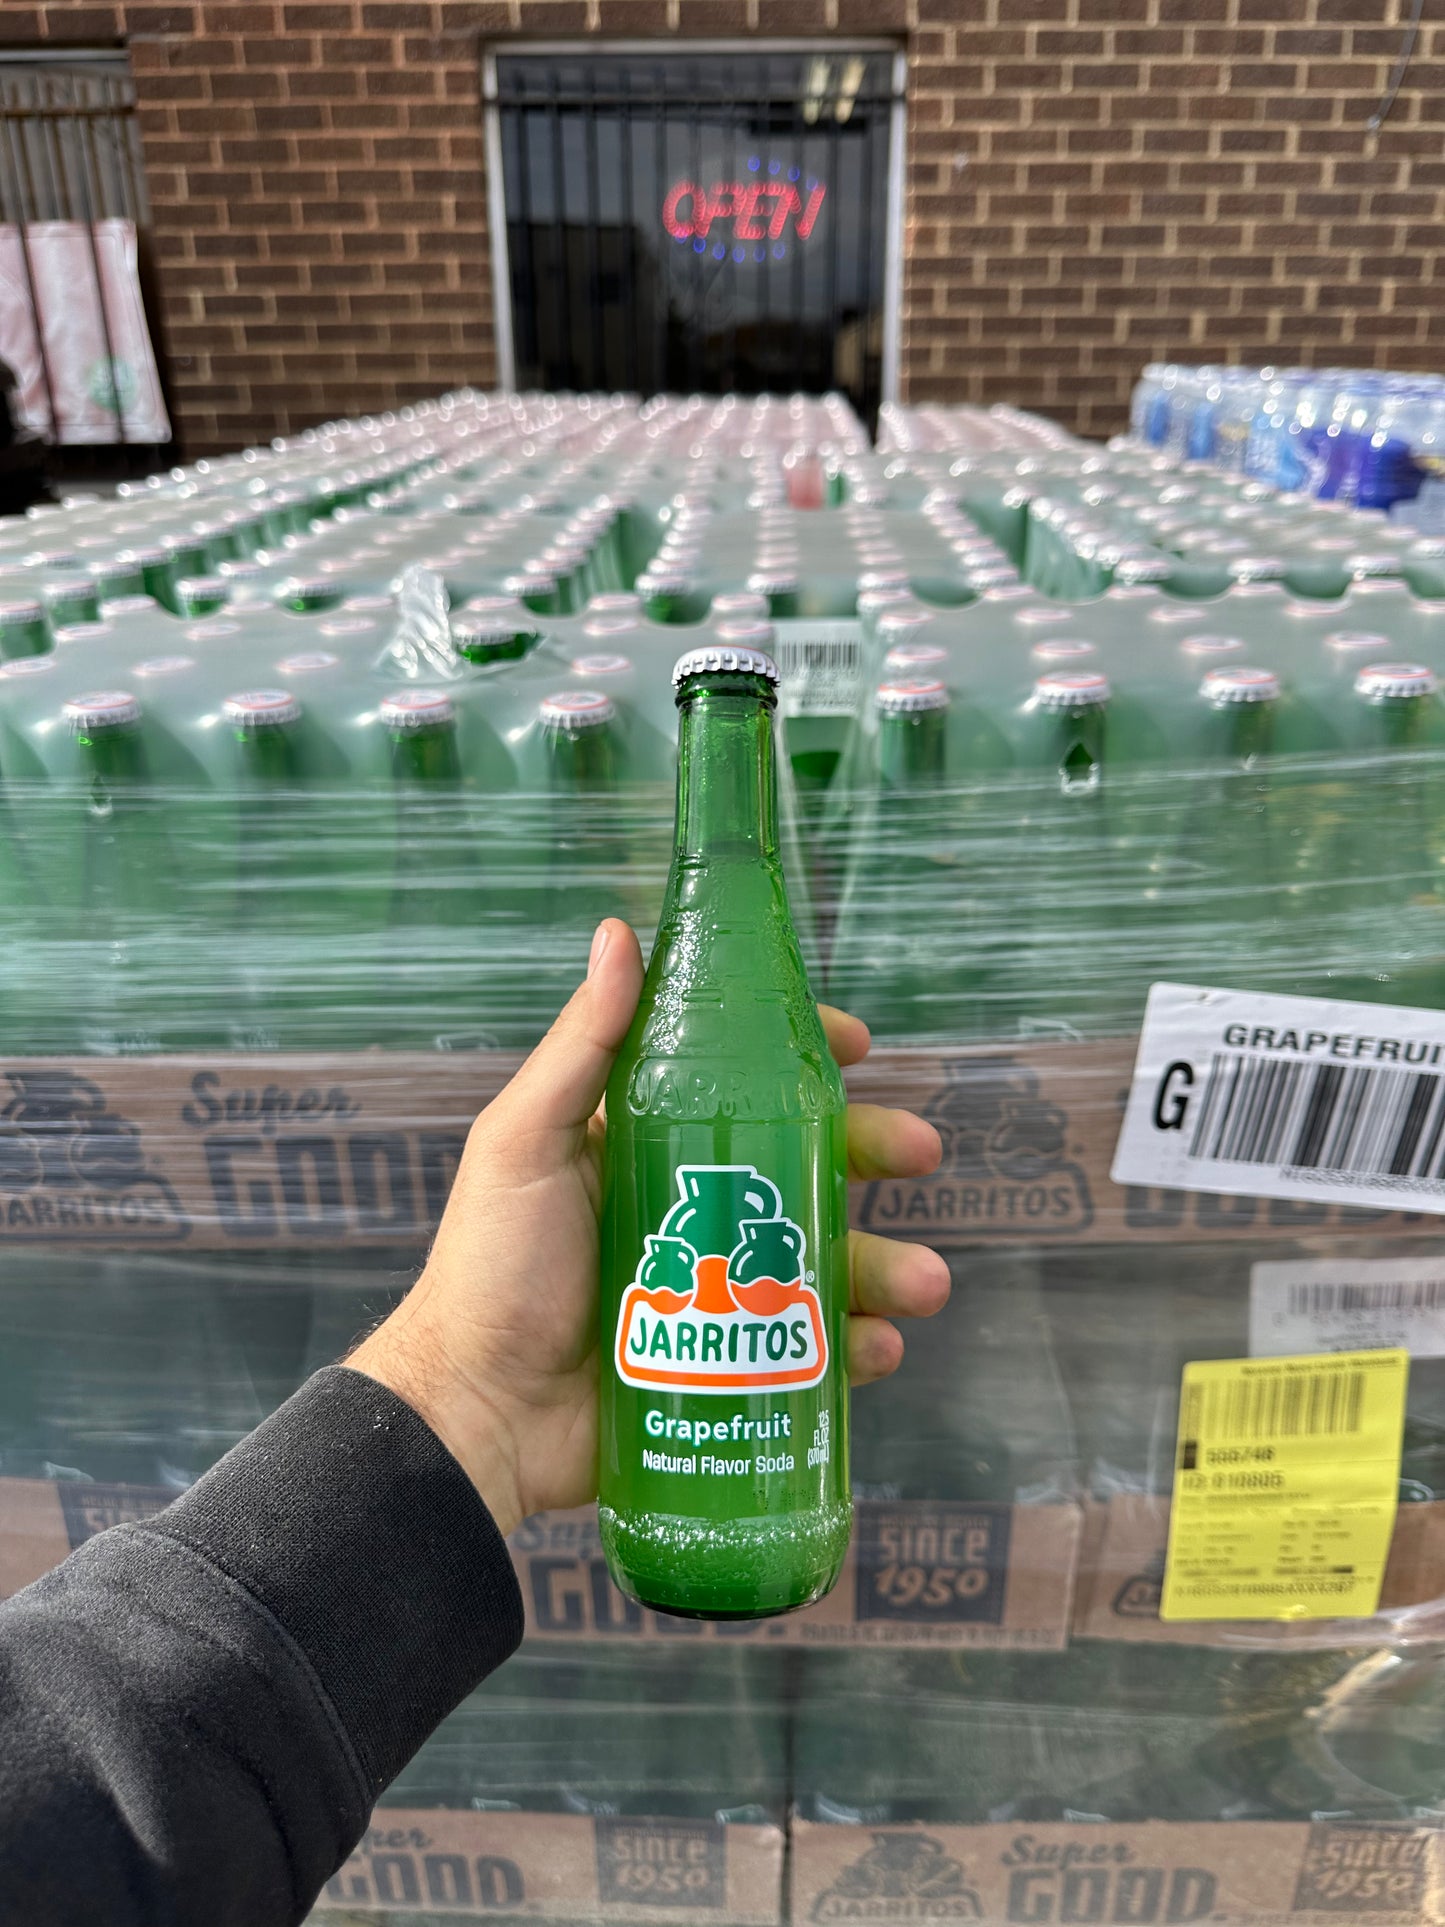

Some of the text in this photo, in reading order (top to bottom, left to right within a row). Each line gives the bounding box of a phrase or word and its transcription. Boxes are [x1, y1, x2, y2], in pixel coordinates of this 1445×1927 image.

[662, 178, 827, 240] OPEN
[1223, 1022, 1444, 1065] GRAPEFRUI
[182, 1070, 361, 1135] Super
[1153, 1061, 1195, 1131] G
[0, 1195, 169, 1226] ARRITOS
[879, 1184, 1073, 1220] JARRITOS
[630, 1315, 808, 1365] JARRITOS
[644, 1408, 792, 1448] Grapefruit
[642, 1448, 796, 1476] Natural Flavor Soda
[873, 1562, 990, 1607] 1950
[1001, 1833, 1134, 1872] Super
[1313, 1867, 1415, 1899] 1950
[825, 1899, 968, 1920] JARRITOS
